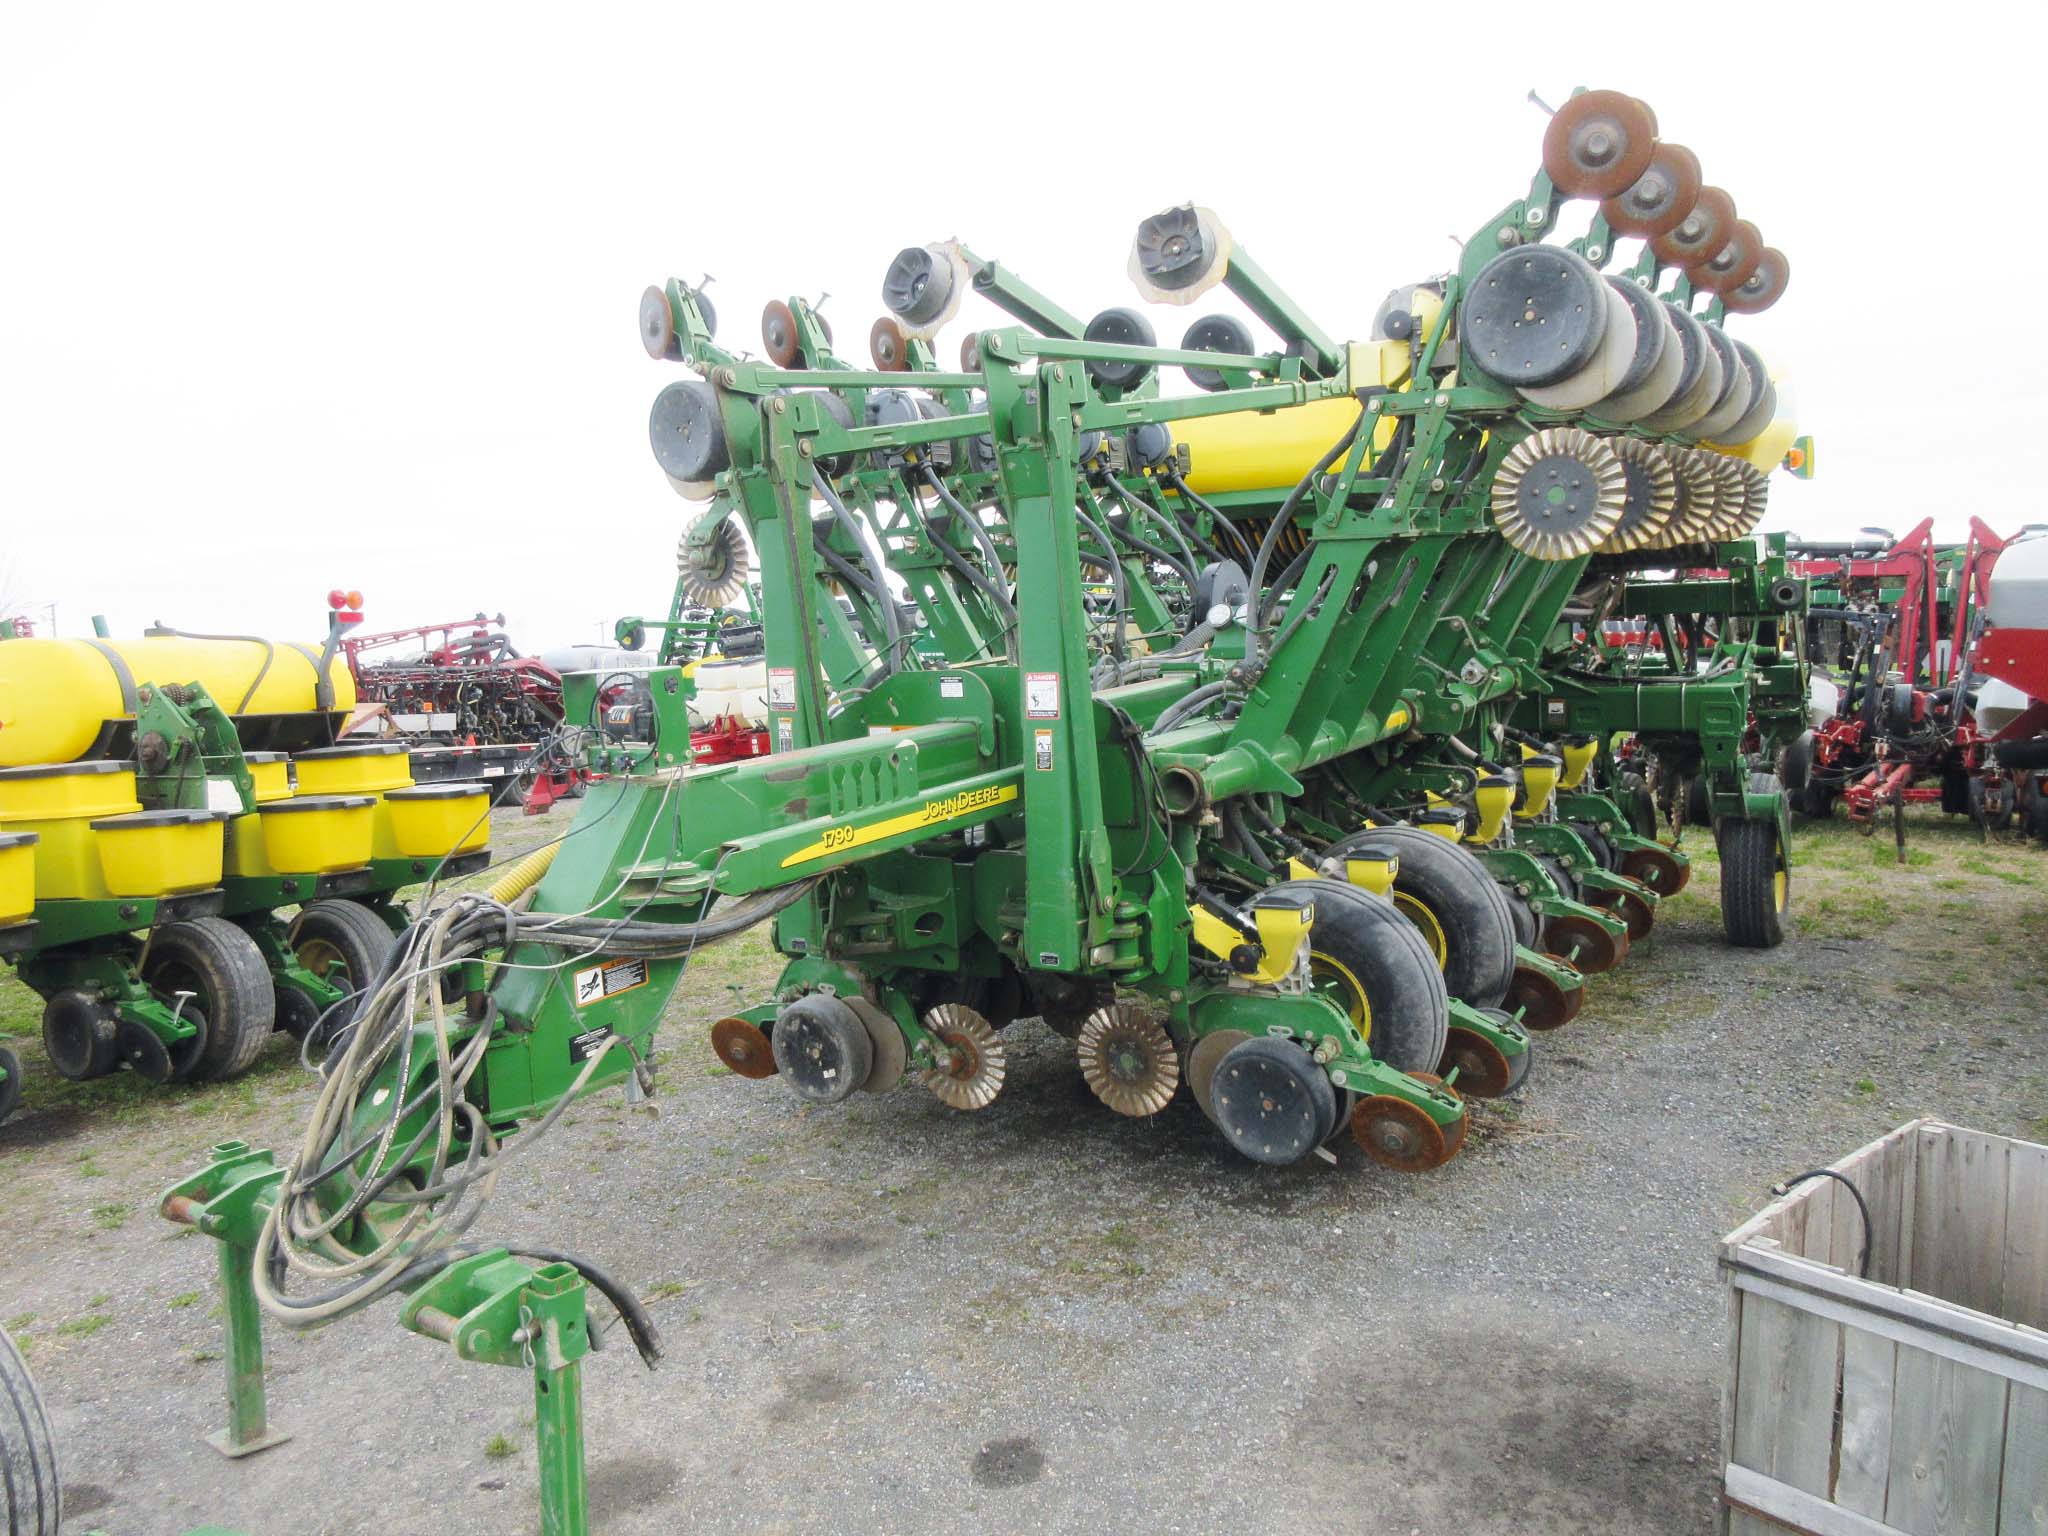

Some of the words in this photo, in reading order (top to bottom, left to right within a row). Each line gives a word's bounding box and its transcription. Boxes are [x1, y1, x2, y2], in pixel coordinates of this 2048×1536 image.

[923, 796, 958, 821] JOHN
[958, 785, 999, 809] DEERE
[821, 826, 853, 848] 1790
